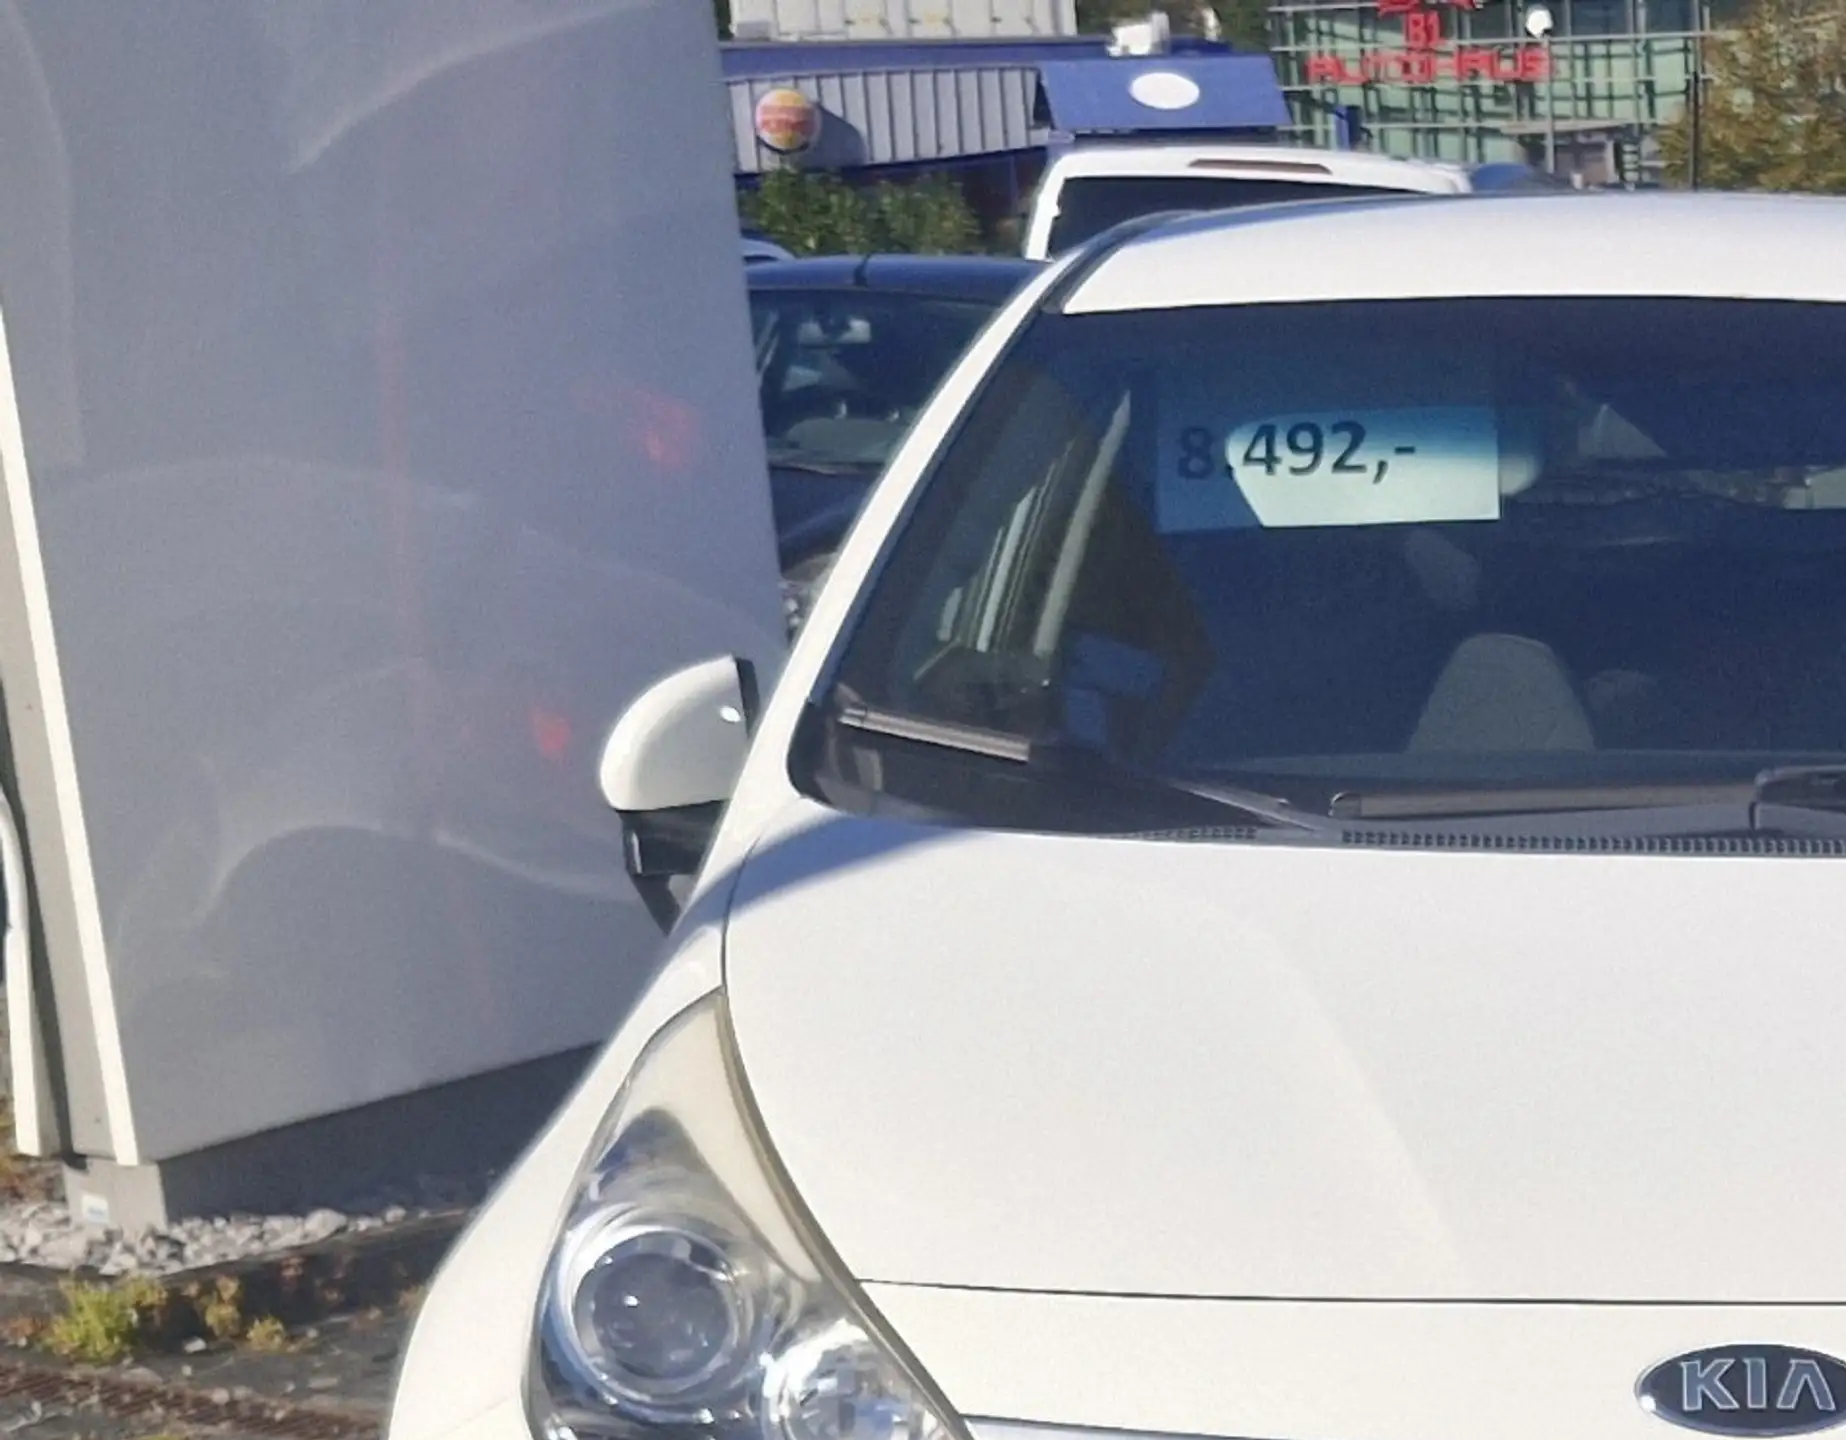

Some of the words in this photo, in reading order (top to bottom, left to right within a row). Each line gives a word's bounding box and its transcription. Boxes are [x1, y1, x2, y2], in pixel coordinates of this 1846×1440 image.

[1305, 47, 1550, 84] AUTOHAUS
[1178, 420, 1416, 484] 8.492,-
[1680, 1356, 1836, 1412] KIA
